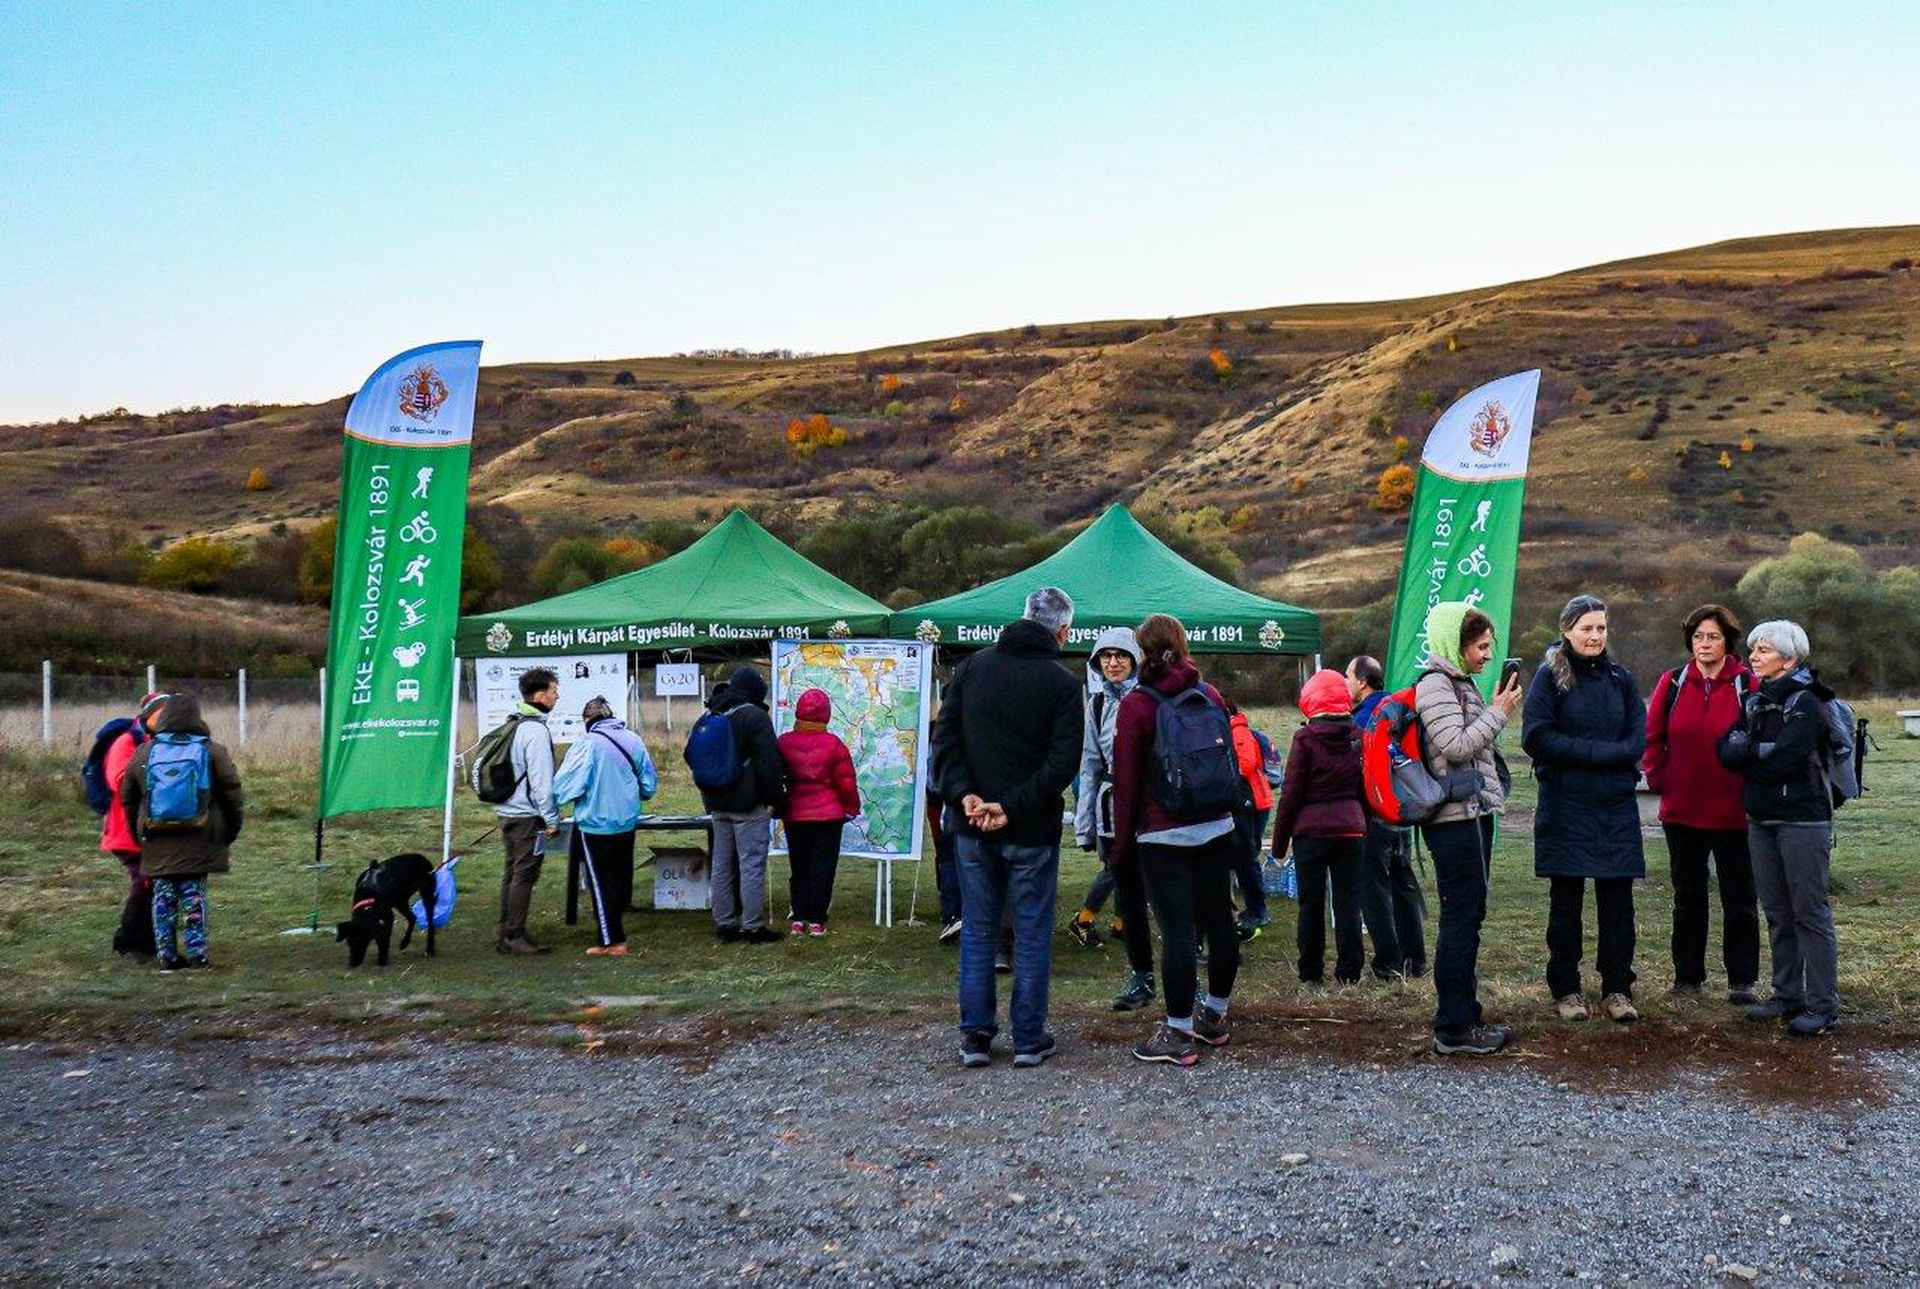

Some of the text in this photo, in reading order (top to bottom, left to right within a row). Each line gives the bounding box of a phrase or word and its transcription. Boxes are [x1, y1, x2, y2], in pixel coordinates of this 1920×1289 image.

[369, 465, 390, 517] 1891
[1431, 498, 1458, 549] 1891
[359, 526, 386, 640] Kolozsvár
[526, 629, 574, 649] Erdélyi
[577, 627, 625, 646] Kárpát
[708, 623, 775, 639] Kolozsvár
[778, 626, 810, 640] 1891
[1211, 626, 1243, 641] 1891
[352, 661, 374, 704] EKE
